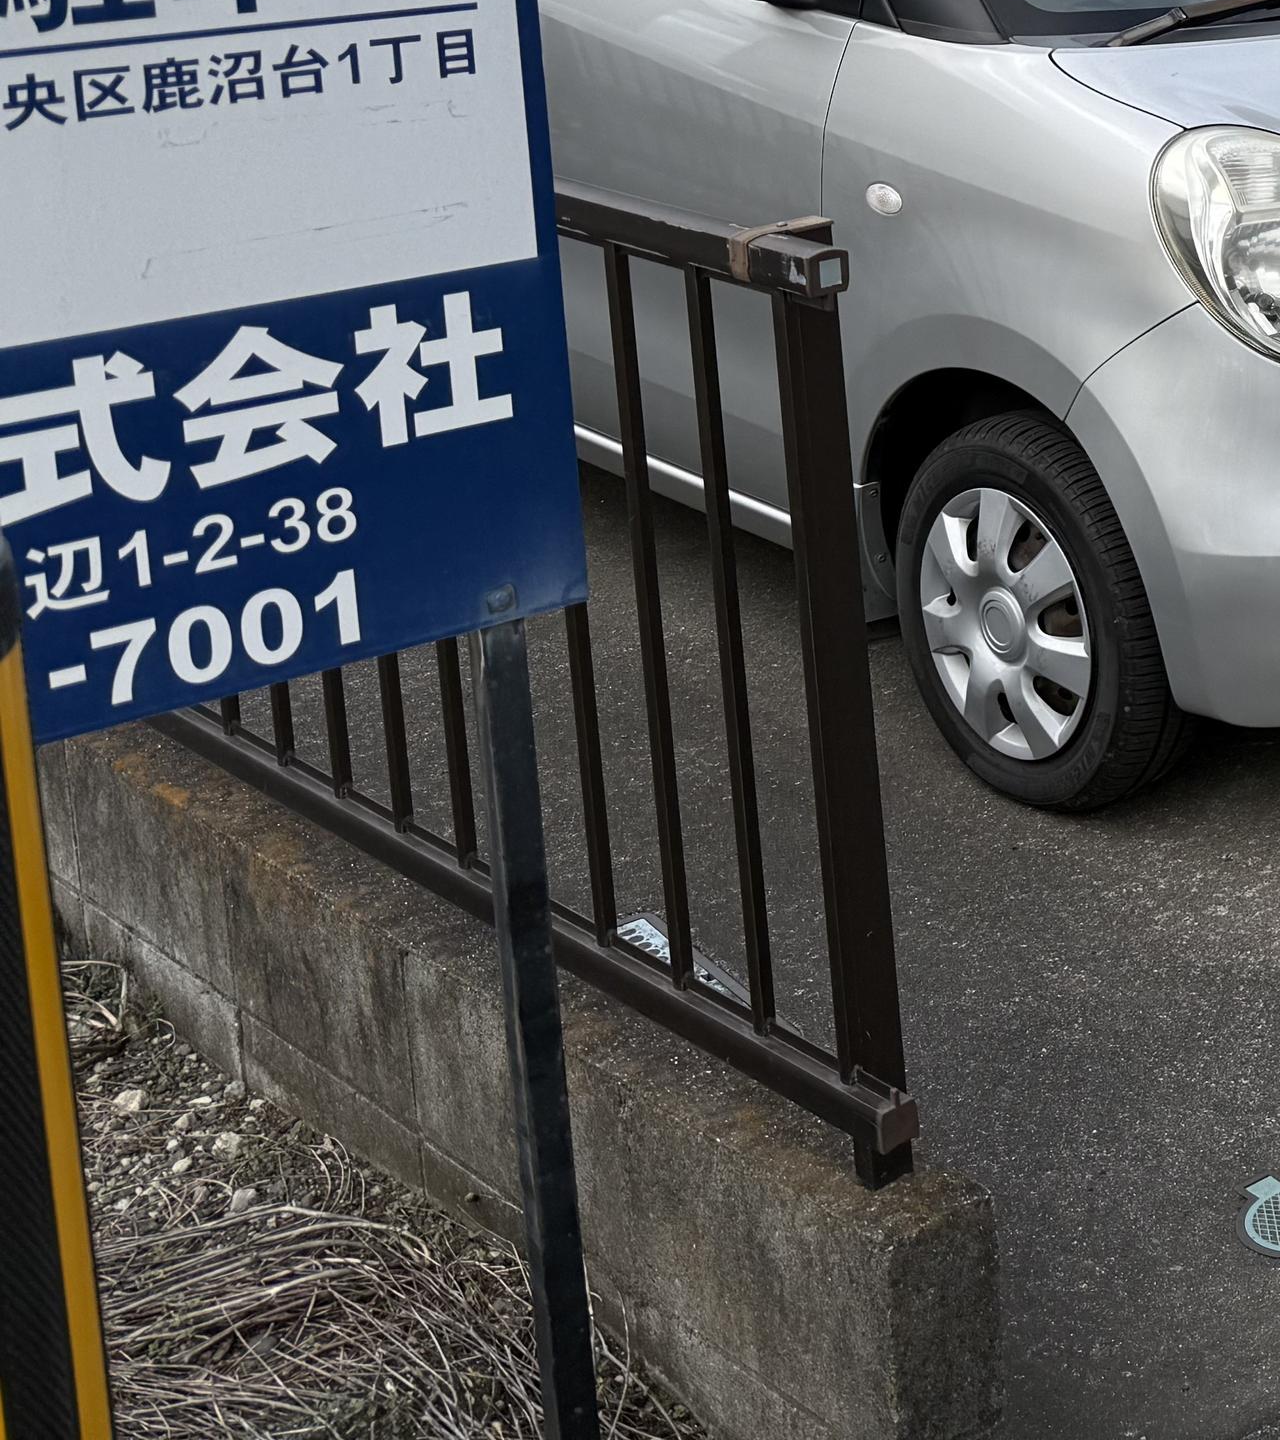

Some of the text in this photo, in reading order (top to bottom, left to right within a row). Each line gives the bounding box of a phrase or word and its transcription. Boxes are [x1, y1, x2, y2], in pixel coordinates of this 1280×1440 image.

[3, 29, 478, 131] 央区鹿沼台1丁目
[0, 291, 514, 527] 式会社
[49, 568, 362, 706] -7001
